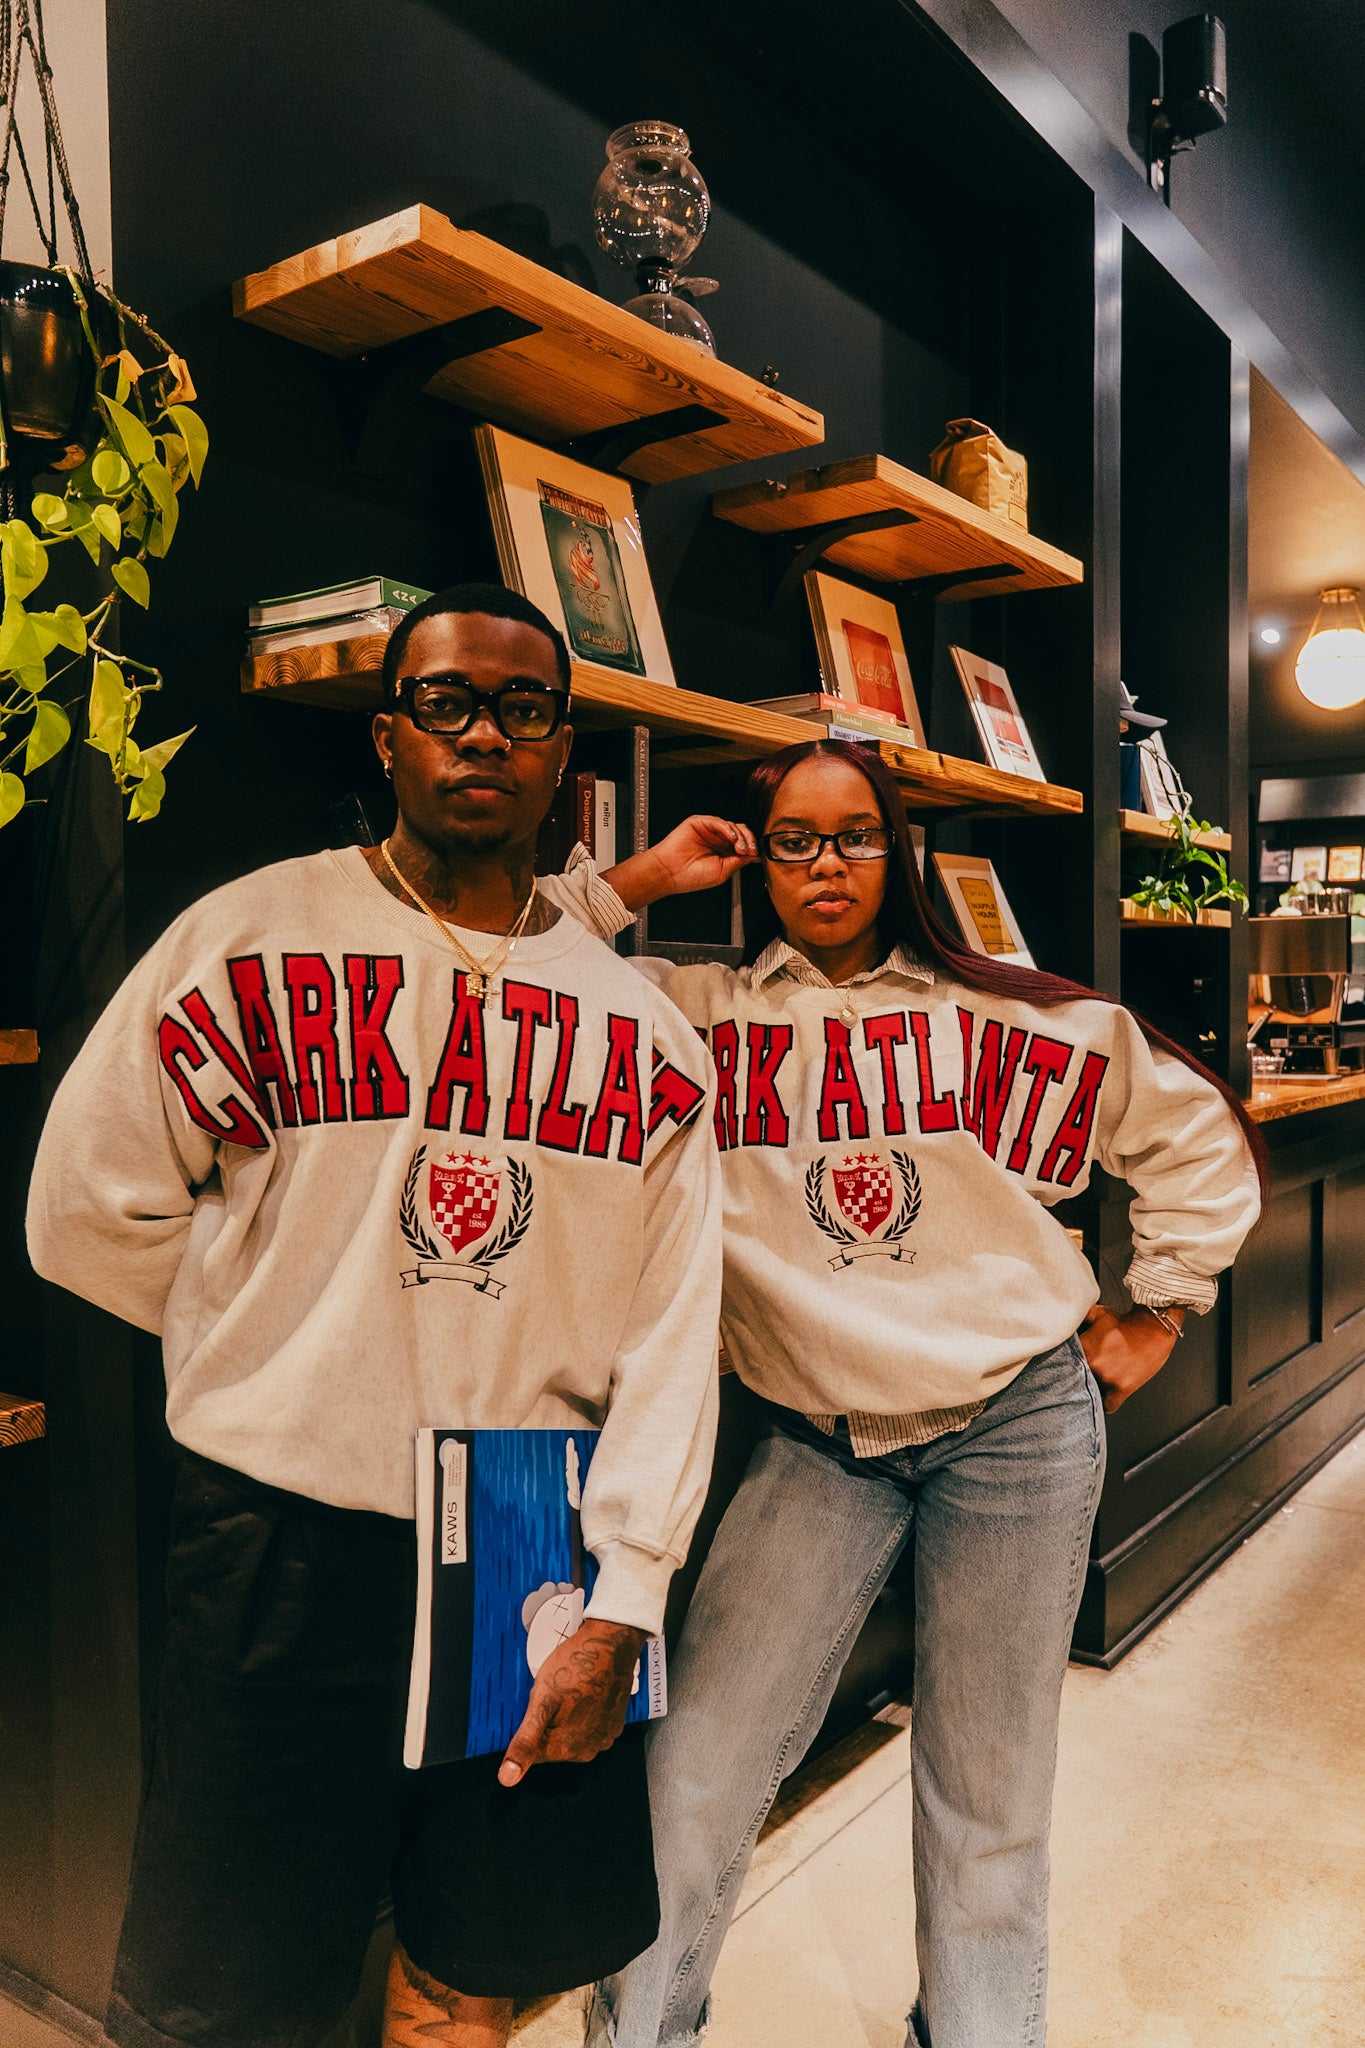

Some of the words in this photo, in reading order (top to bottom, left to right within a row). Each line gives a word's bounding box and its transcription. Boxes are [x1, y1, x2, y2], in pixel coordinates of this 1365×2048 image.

[583, 790, 592, 842] Designed
[447, 1501, 458, 1556] KAWS
[652, 1640, 661, 1713] PHAIDON
